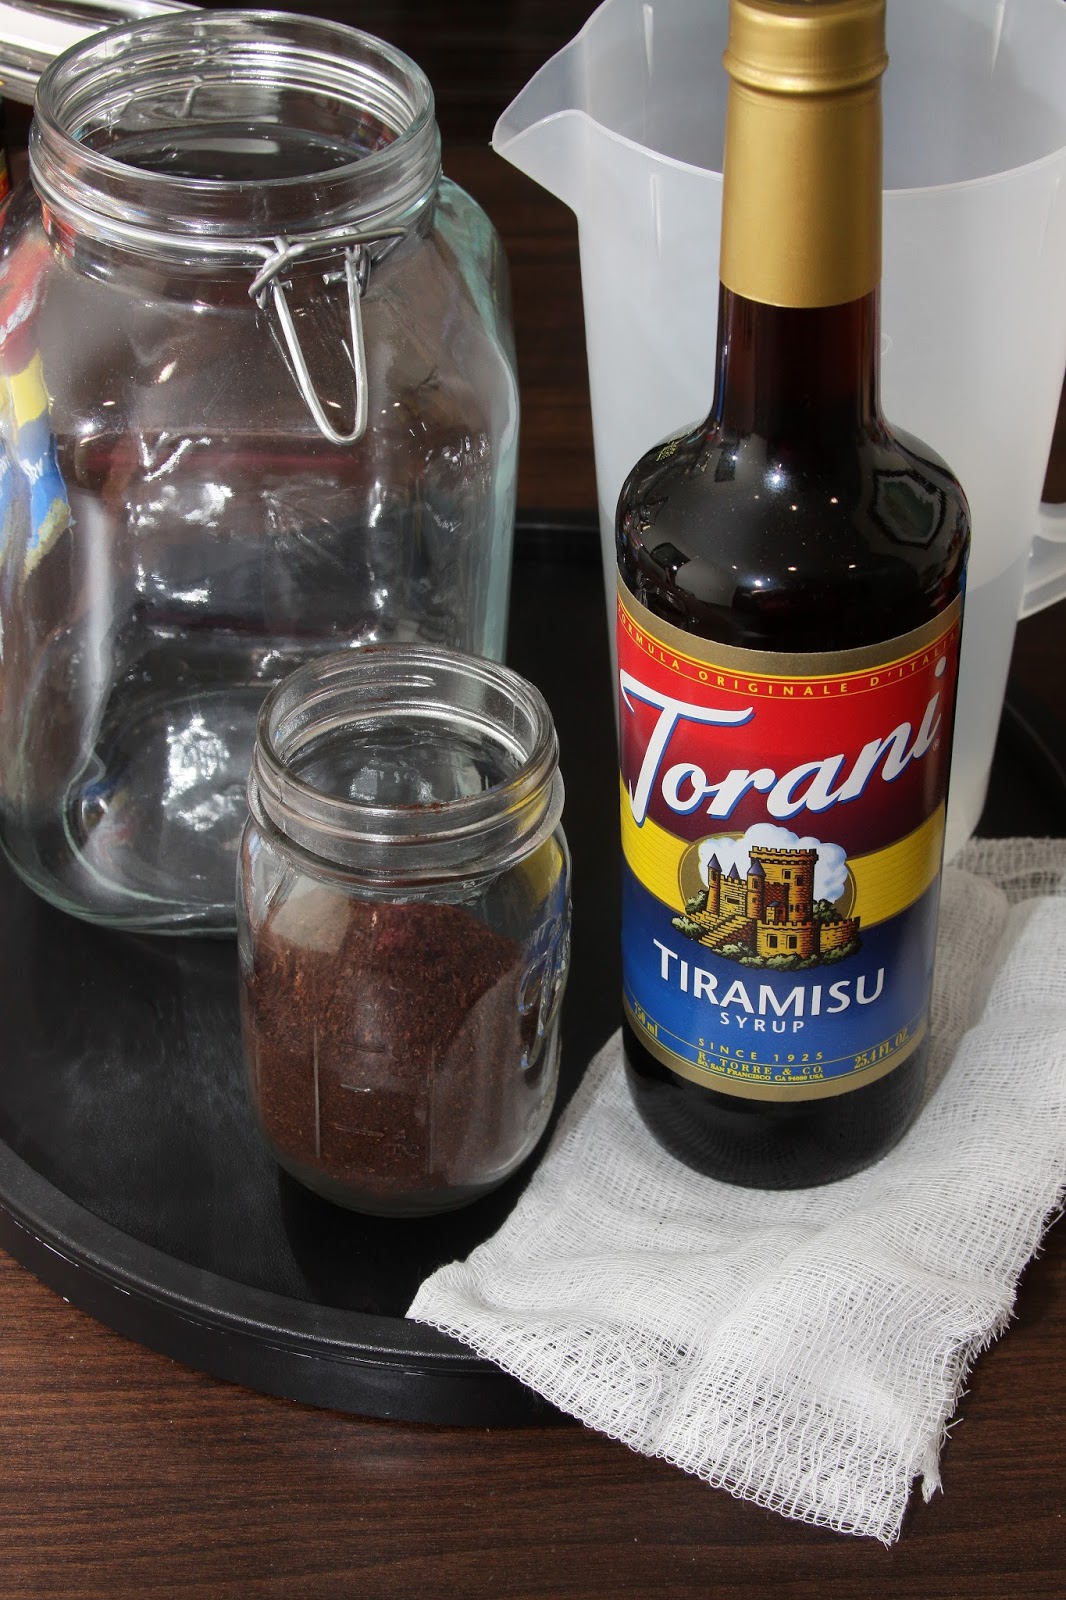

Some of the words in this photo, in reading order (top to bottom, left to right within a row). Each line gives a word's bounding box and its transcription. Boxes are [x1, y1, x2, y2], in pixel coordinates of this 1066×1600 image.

[698, 671, 848, 696] ORIGINALE
[619, 656, 947, 828] Torani
[653, 938, 885, 1017] TIRAMISU
[647, 1022, 658, 1037] ml
[720, 1012, 805, 1033] SYRUP
[698, 1037, 757, 1060] SINCE
[774, 1052, 823, 1063] 1925
[854, 1049, 877, 1069] 25.4
[698, 1051, 710, 1061] R.
[719, 1059, 772, 1075] TORRE
[782, 1067, 792, 1075] &
[802, 1066, 824, 1075] CO.
[710, 1063, 725, 1073] SAN
[727, 1067, 771, 1081] FRANCISCO
